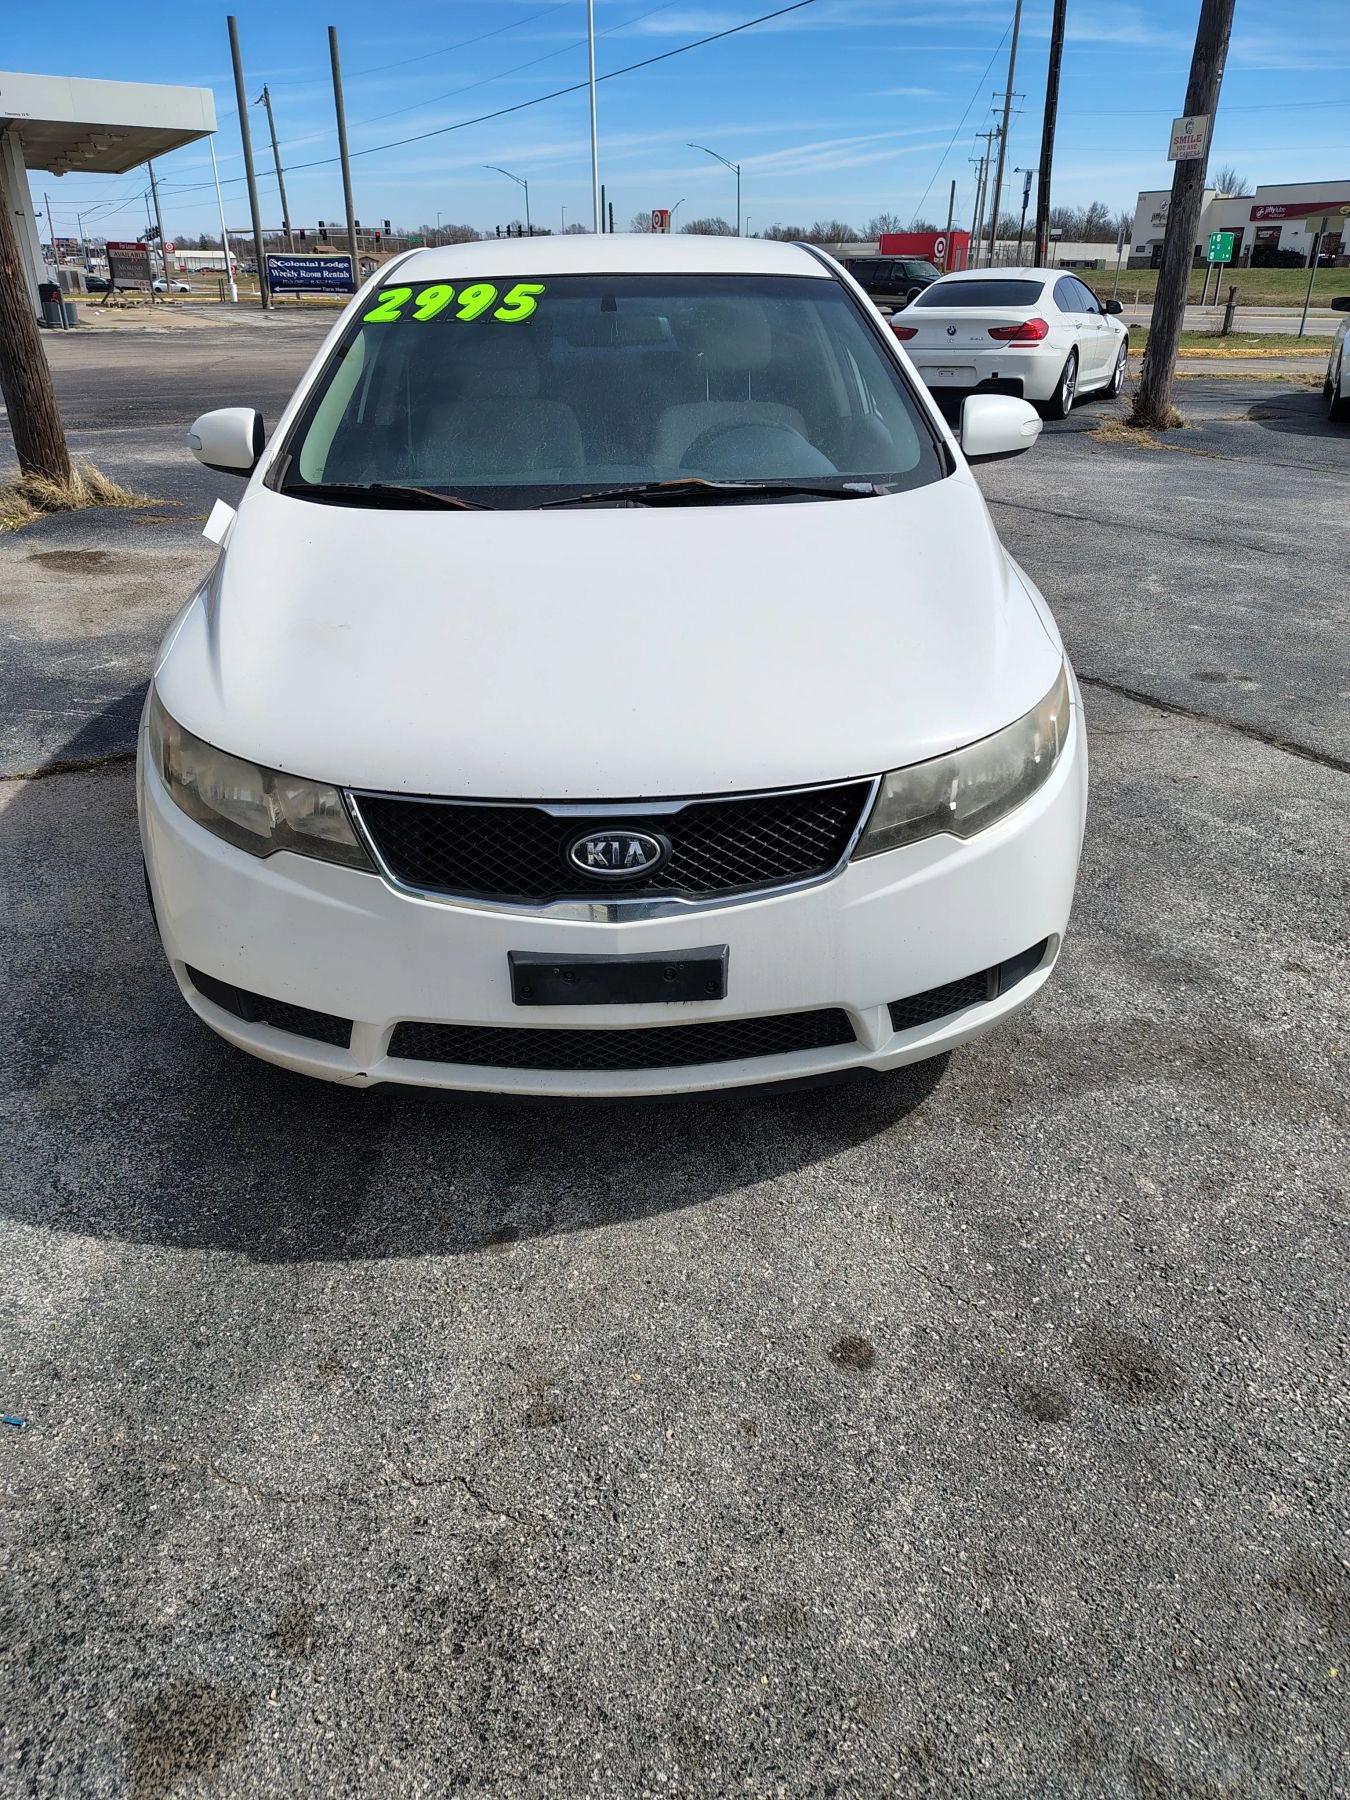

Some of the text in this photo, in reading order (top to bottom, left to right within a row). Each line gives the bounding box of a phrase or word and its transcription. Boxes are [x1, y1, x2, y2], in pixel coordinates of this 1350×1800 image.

[1173, 134, 1202, 145] SMILE
[320, 261, 350, 269] Lodge
[271, 269, 350, 279] Weekly Room Rentals
[362, 282, 546, 324] 2995
[585, 841, 647, 866] KIA
